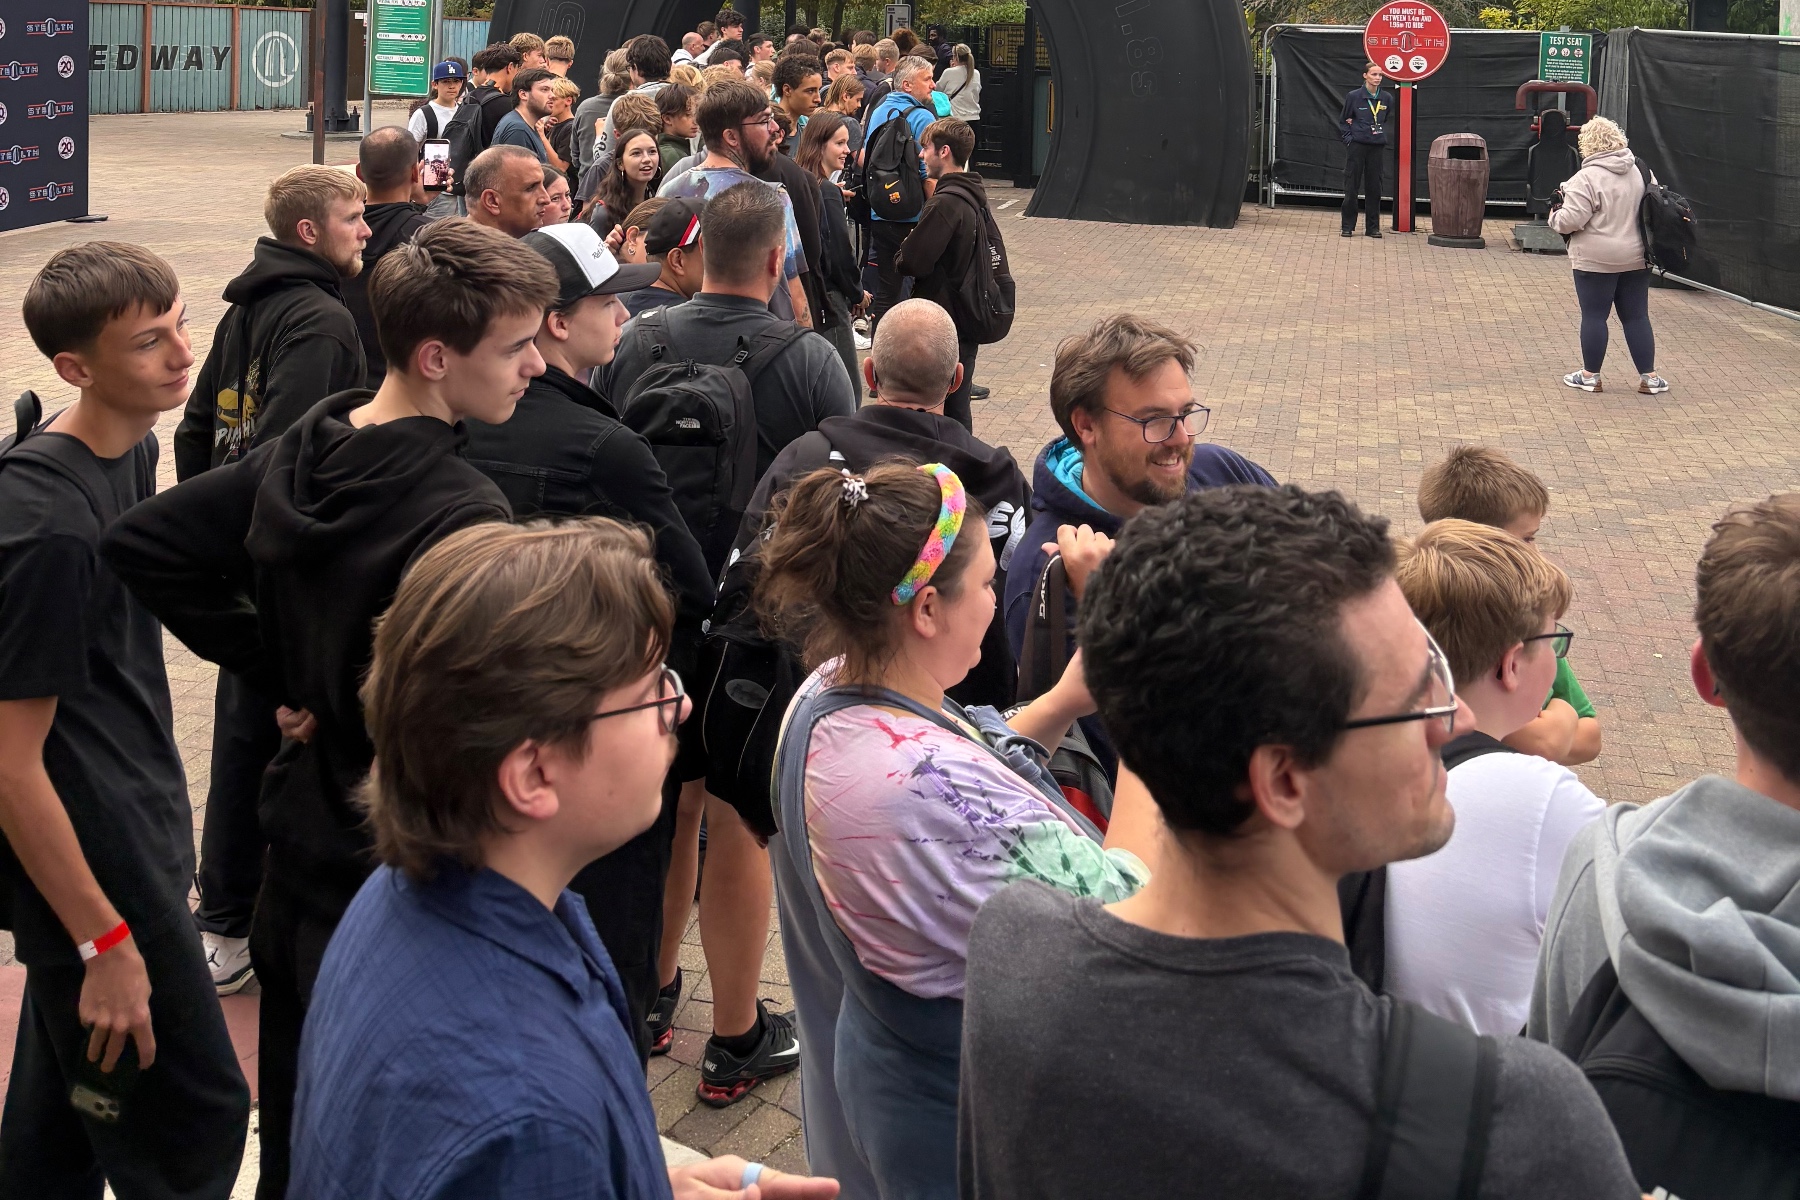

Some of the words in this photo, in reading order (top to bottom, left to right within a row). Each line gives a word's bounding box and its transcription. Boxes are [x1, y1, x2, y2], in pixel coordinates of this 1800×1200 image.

[1550, 36, 1566, 45] TEST
[1567, 37, 1583, 47] SEAT
[703, 1059, 718, 1073] NIKE
